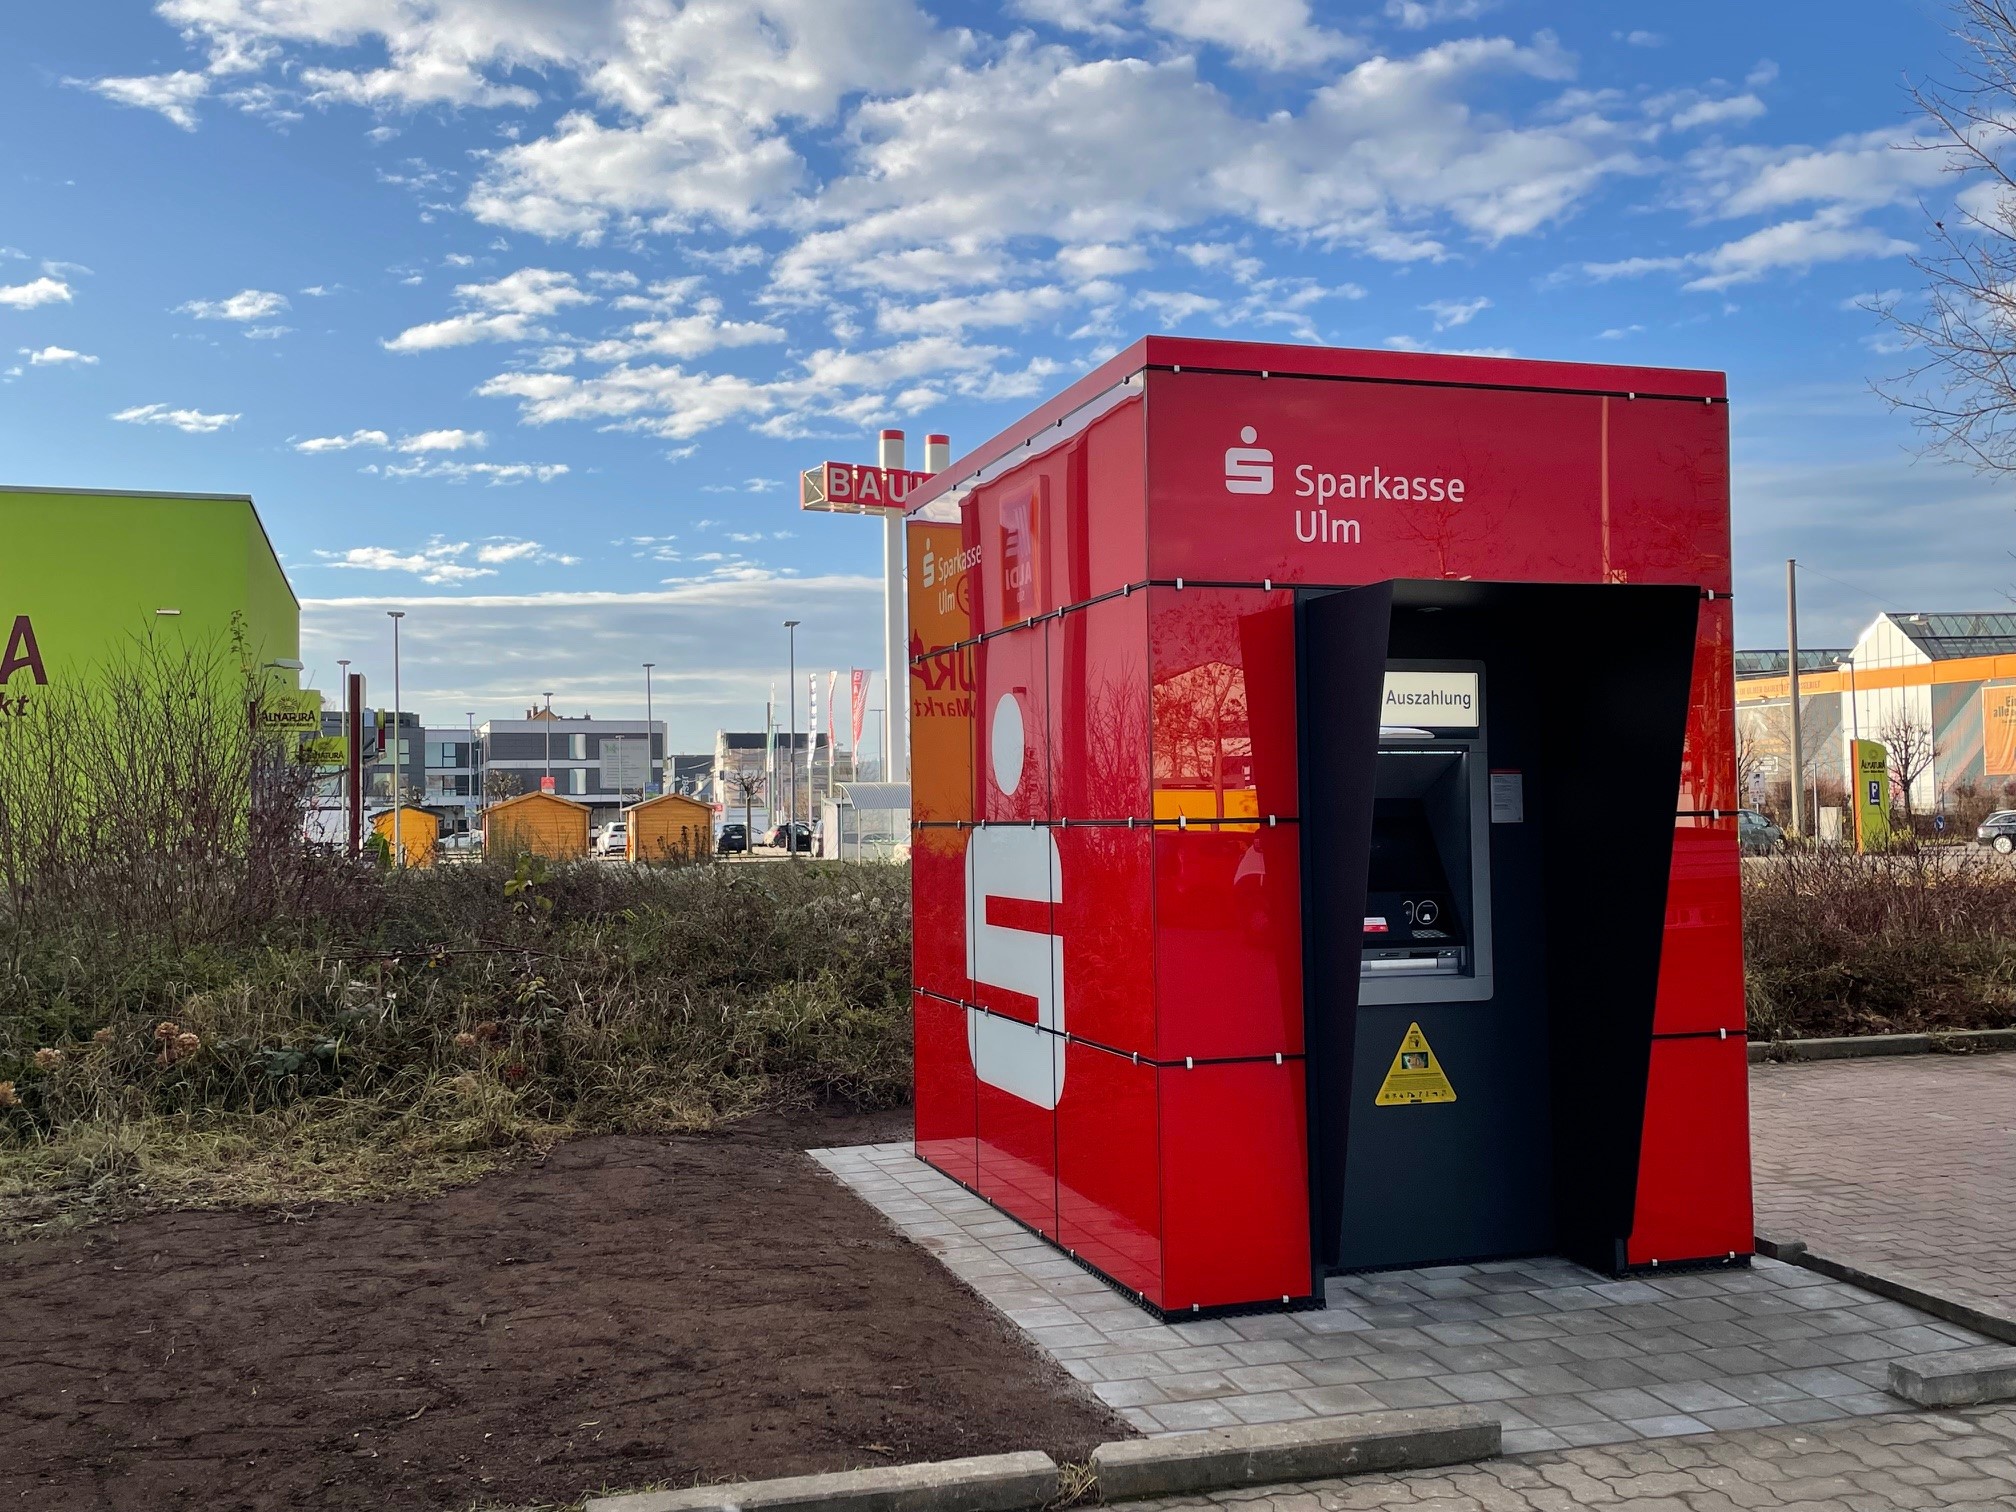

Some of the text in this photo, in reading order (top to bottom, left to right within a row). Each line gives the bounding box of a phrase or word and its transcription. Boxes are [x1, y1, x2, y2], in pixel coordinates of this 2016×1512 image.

[829, 467, 925, 503] BAU
[1295, 464, 1465, 506] Sparkasse
[1295, 509, 1361, 544] Ulm
[938, 544, 982, 586] Sparkasse
[938, 588, 956, 615] Ulm
[1386, 689, 1472, 711] Auszahlung
[262, 710, 316, 722] ALNATURA
[1871, 782, 1879, 798] P
